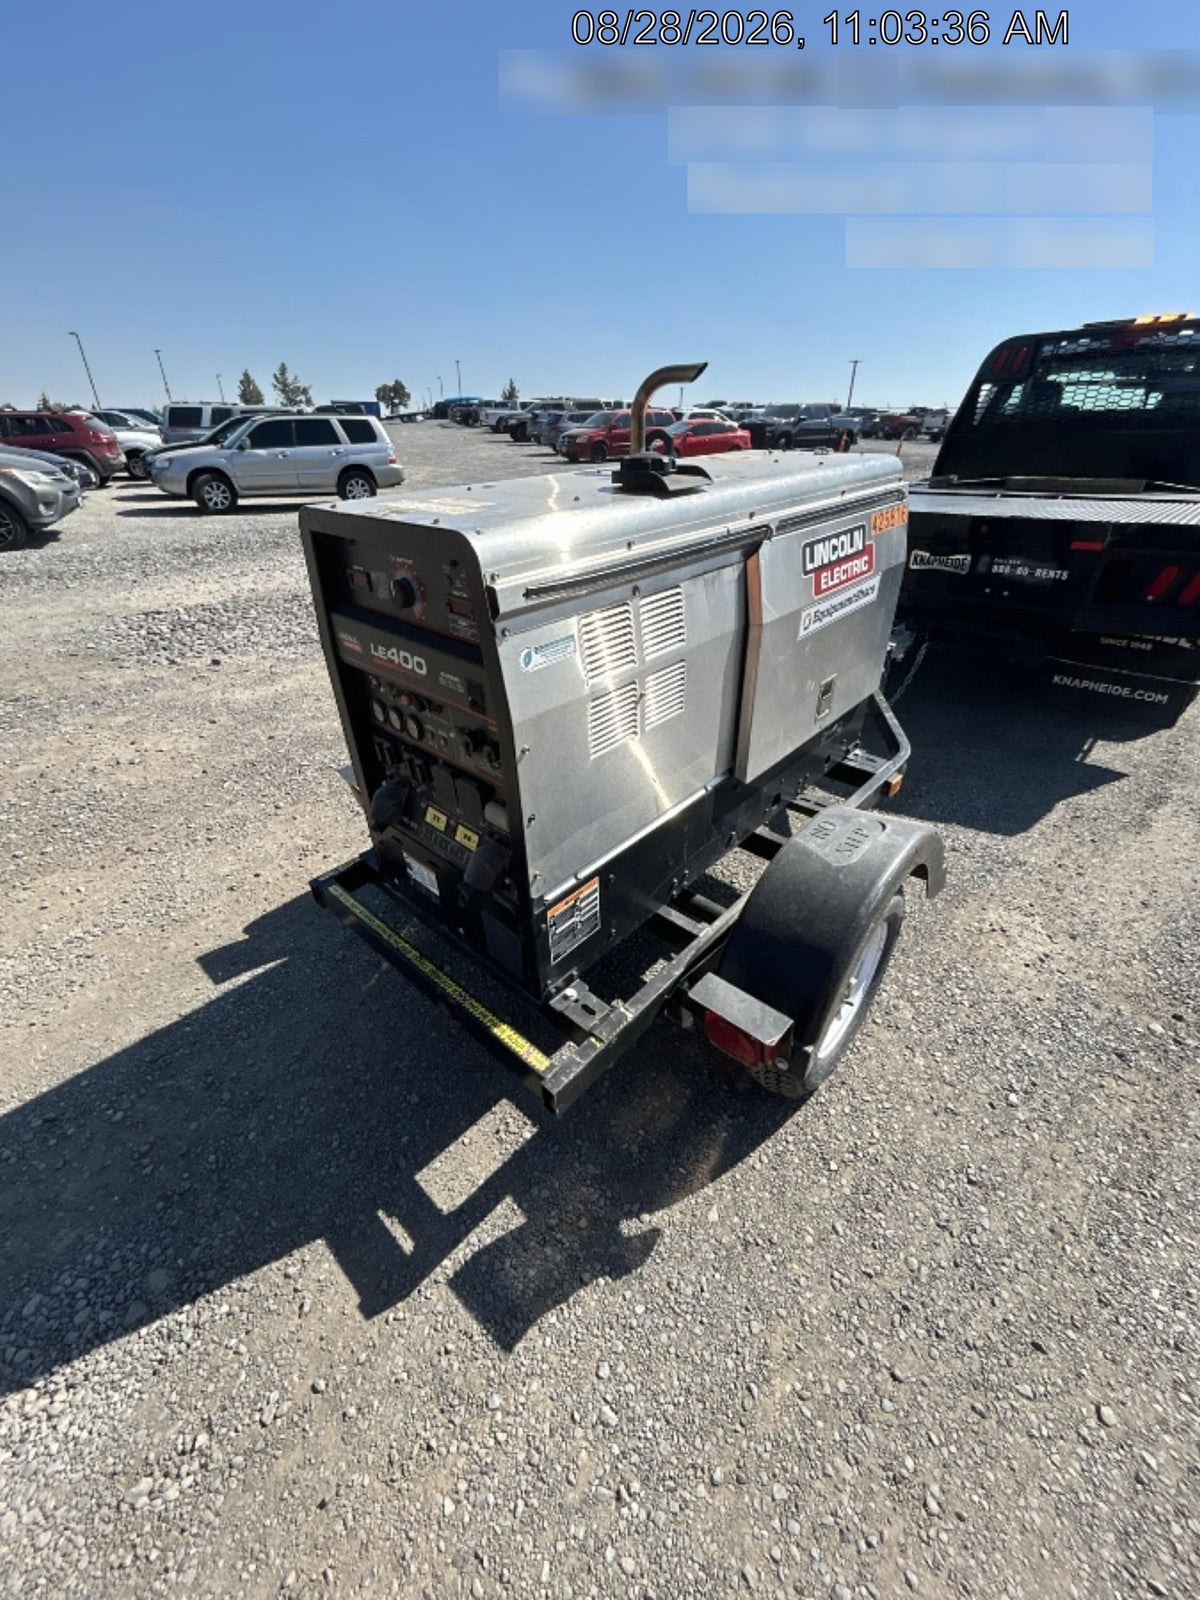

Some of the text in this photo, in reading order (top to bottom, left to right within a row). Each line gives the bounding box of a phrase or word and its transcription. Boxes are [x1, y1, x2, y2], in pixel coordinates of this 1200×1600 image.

[805, 528, 864, 571] LINCOLN
[820, 556, 869, 590] ELECTRIC
[370, 643, 428, 676] LE400
[1052, 674, 1169, 705] KNAPHEIDE.COM
